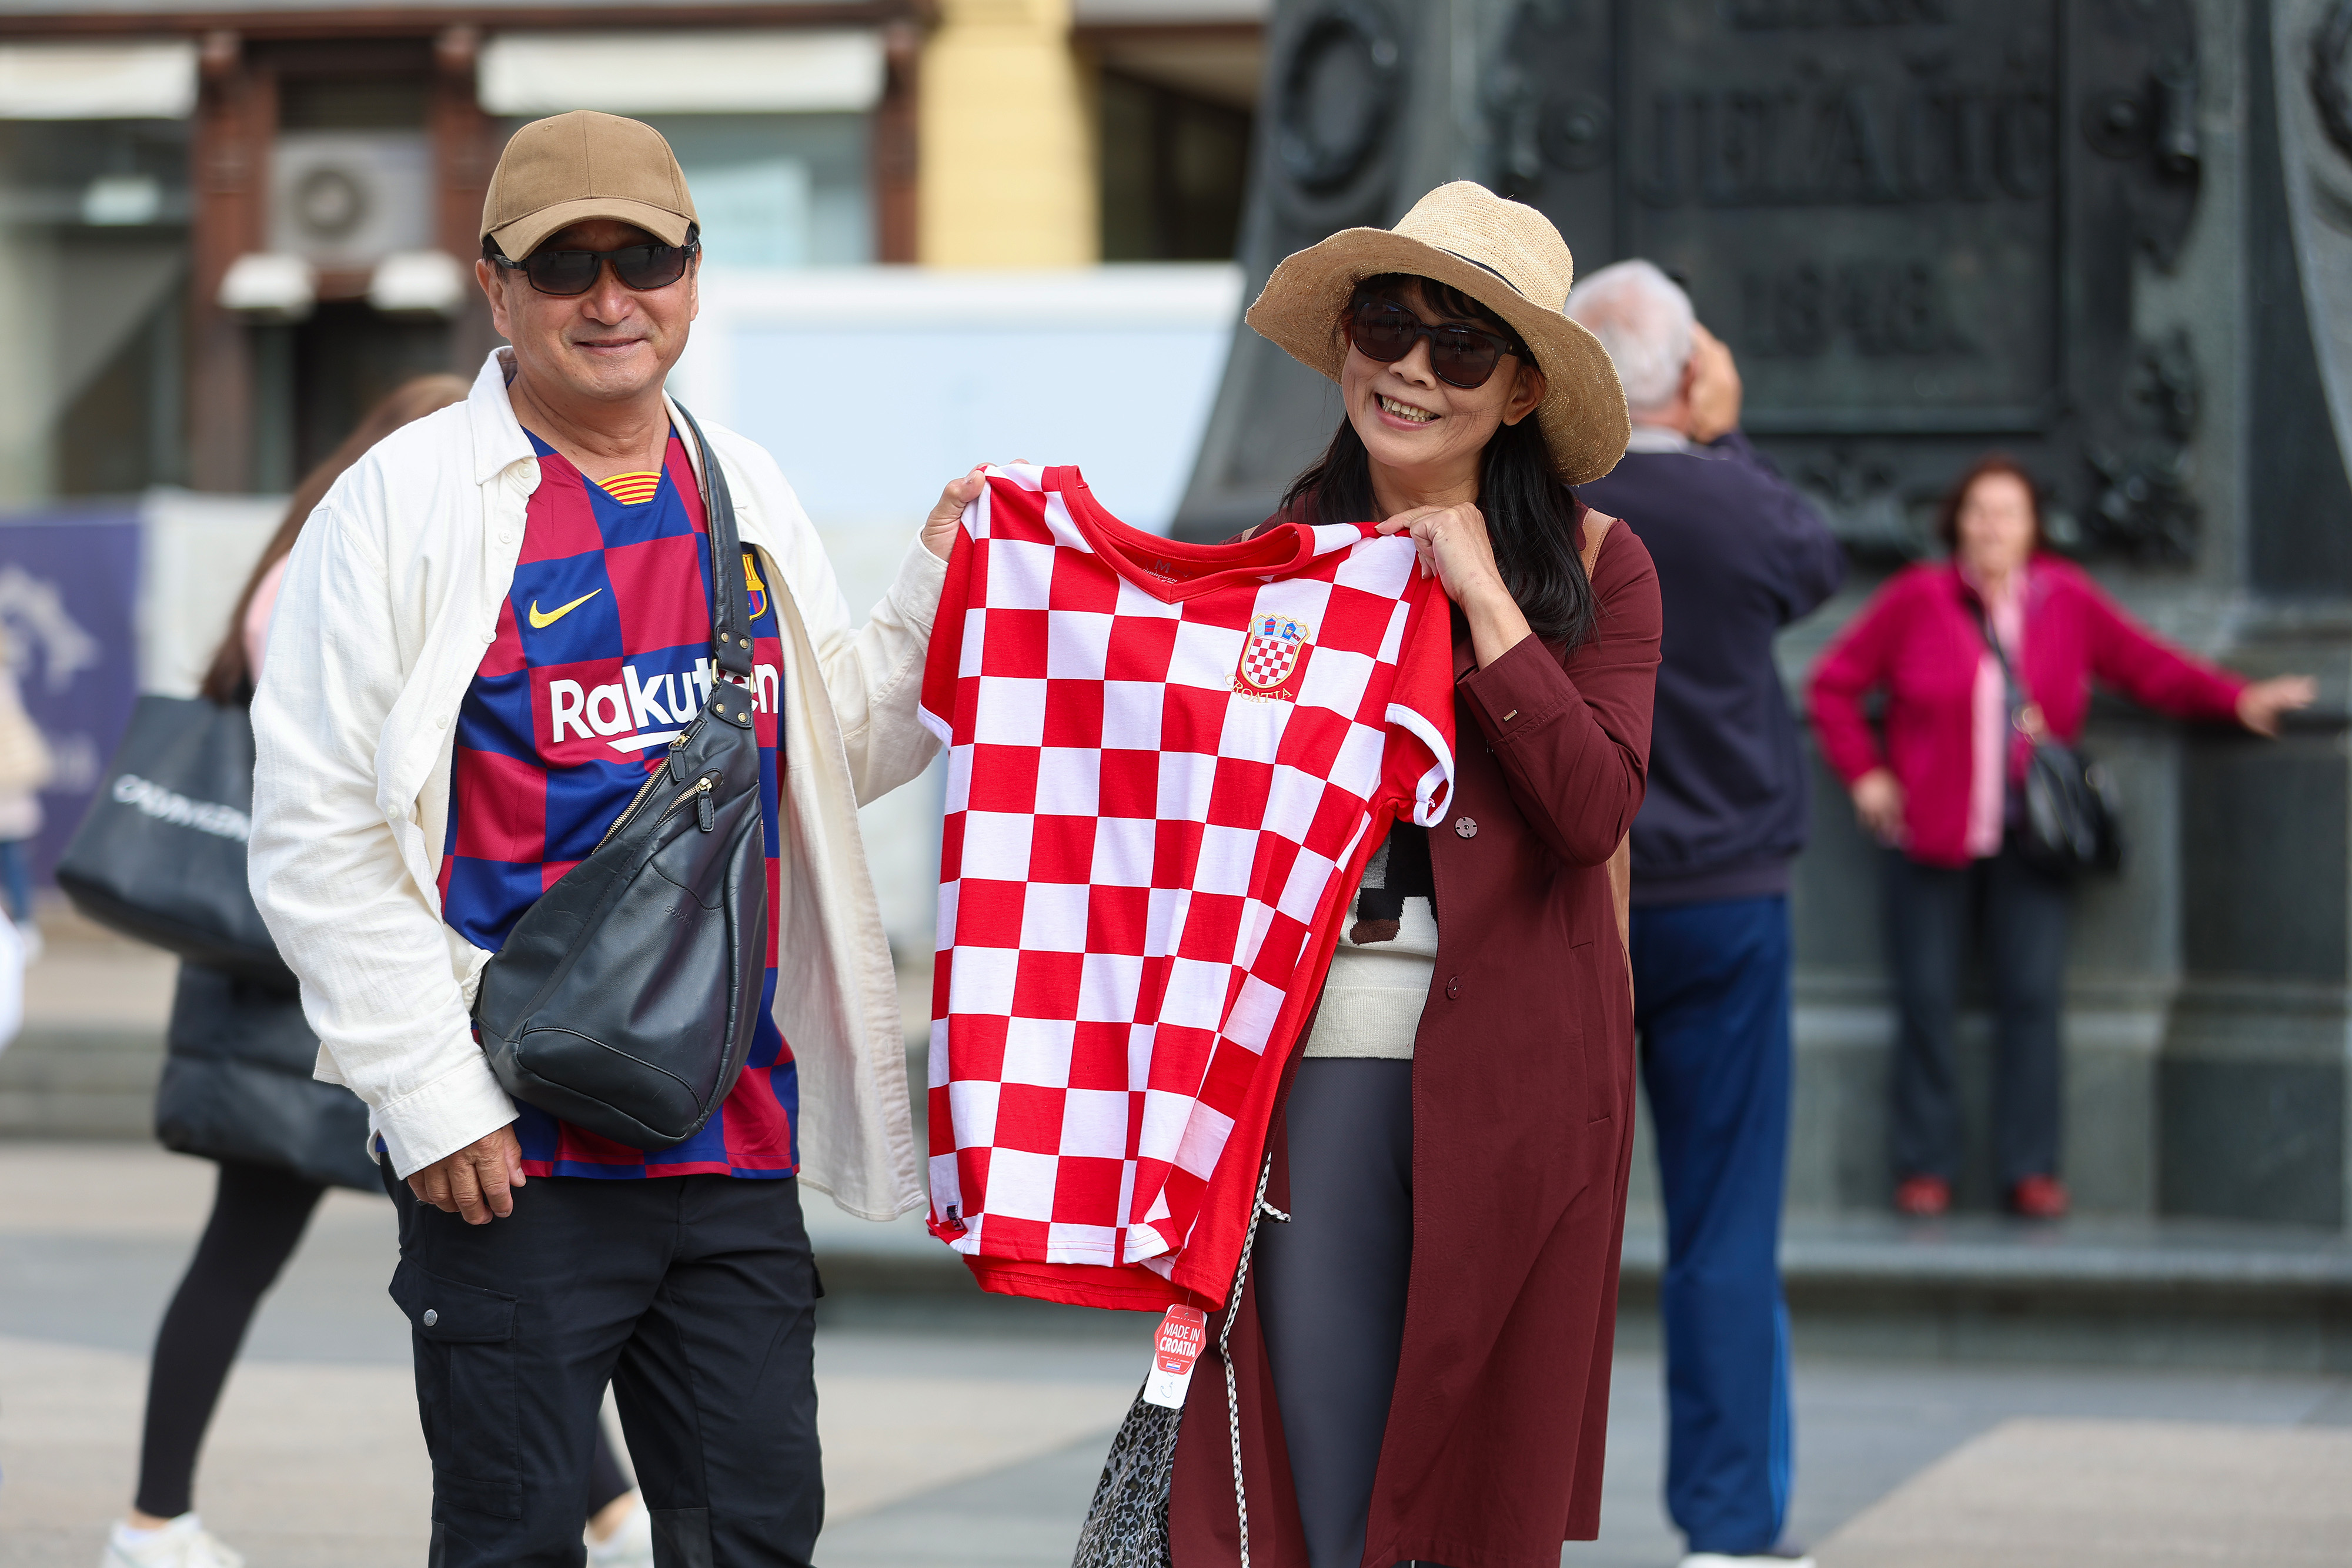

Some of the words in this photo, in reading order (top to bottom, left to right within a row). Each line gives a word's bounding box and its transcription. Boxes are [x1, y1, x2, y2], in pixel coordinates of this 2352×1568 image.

[1141, 568, 1178, 582] NBROKEN
[1154, 559, 1171, 573] M
[1225, 673, 1294, 703] CROATIA
[1163, 1322, 1190, 1339] MADE
[1189, 1328, 1201, 1342] IN
[1160, 1336, 1197, 1358] CROATIA
